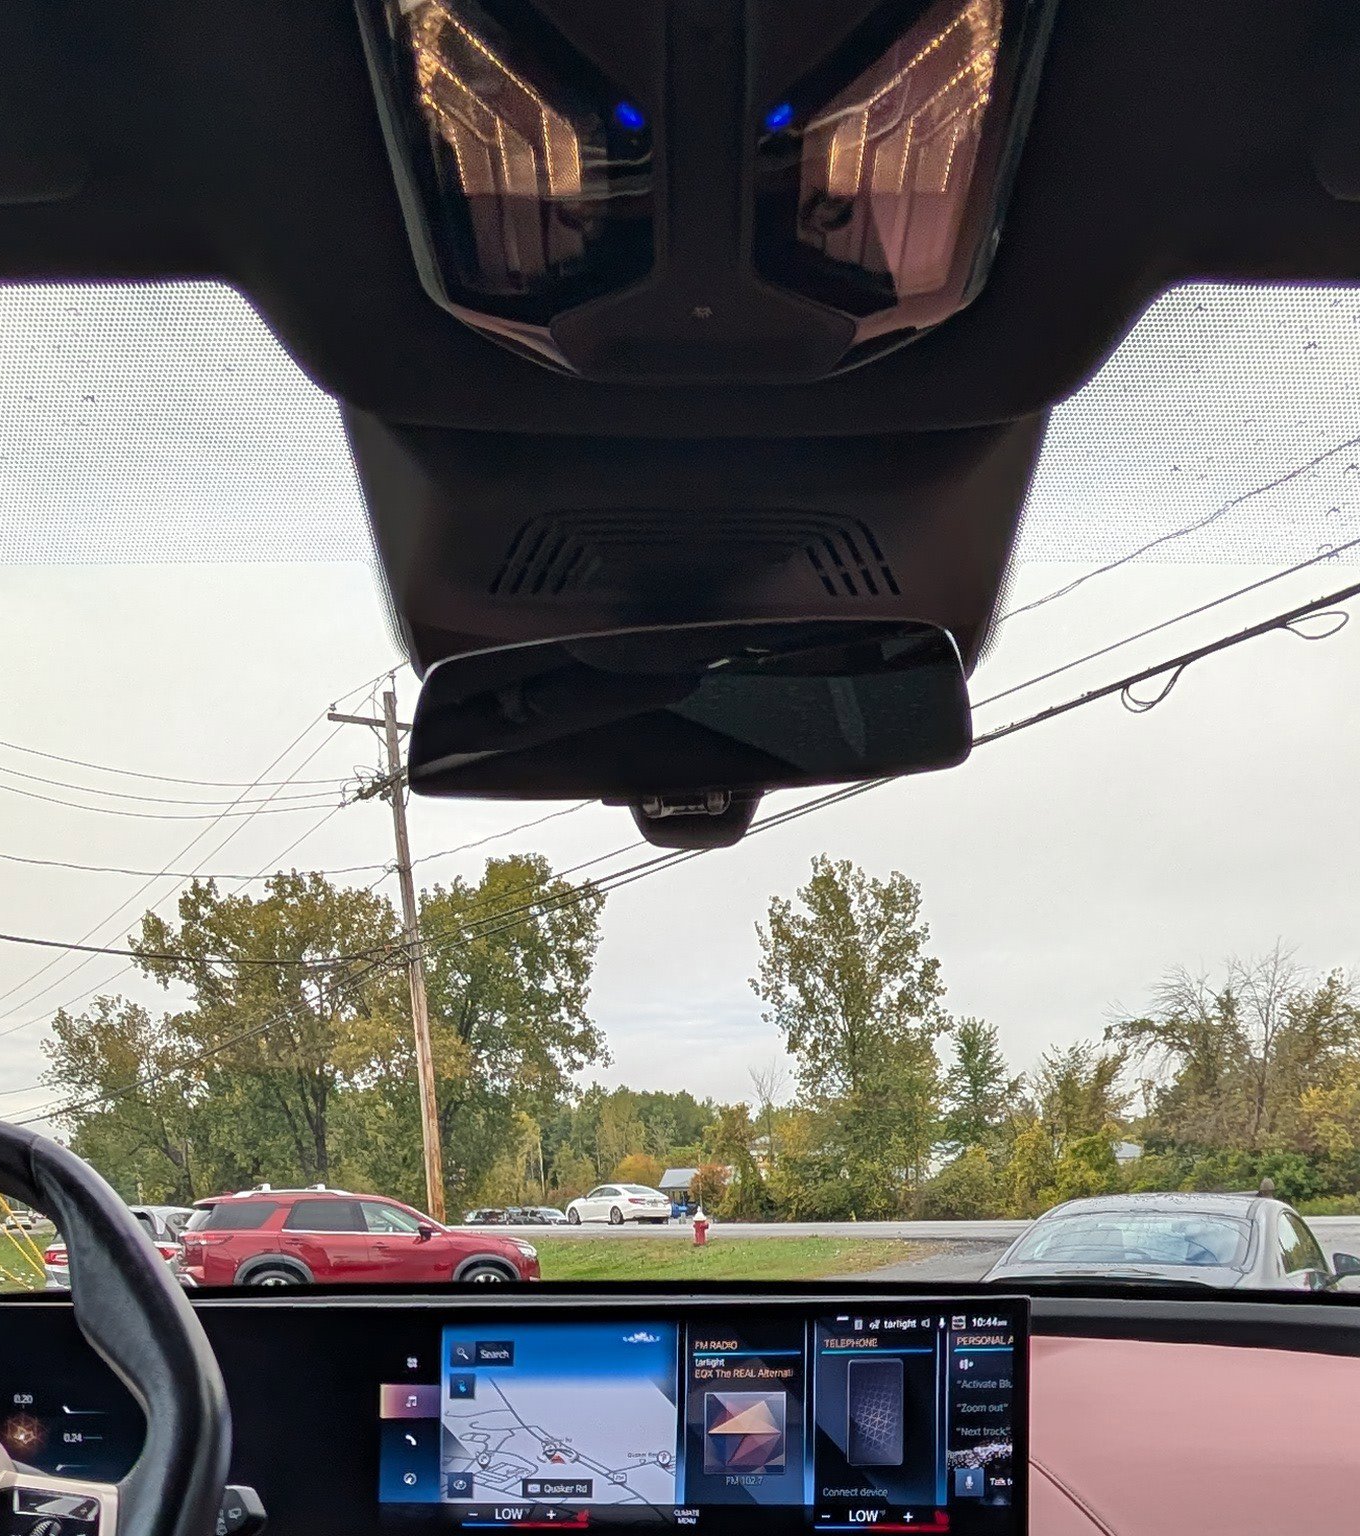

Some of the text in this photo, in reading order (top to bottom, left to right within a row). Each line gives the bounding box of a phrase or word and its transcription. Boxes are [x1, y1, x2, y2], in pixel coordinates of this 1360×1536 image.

[709, 1340, 738, 1350] RADIO
[824, 1338, 879, 1348] TELEPHONE
[956, 1335, 1004, 1345] PERSONAL
[479, 1349, 510, 1360] Search
[733, 1369, 756, 1378] REAL
[543, 1484, 575, 1494] Quaker
[575, 1484, 588, 1493] Rd
[822, 1486, 889, 1497] Connect device
[494, 1508, 523, 1520] LOW
[848, 1510, 879, 1522] LOW
